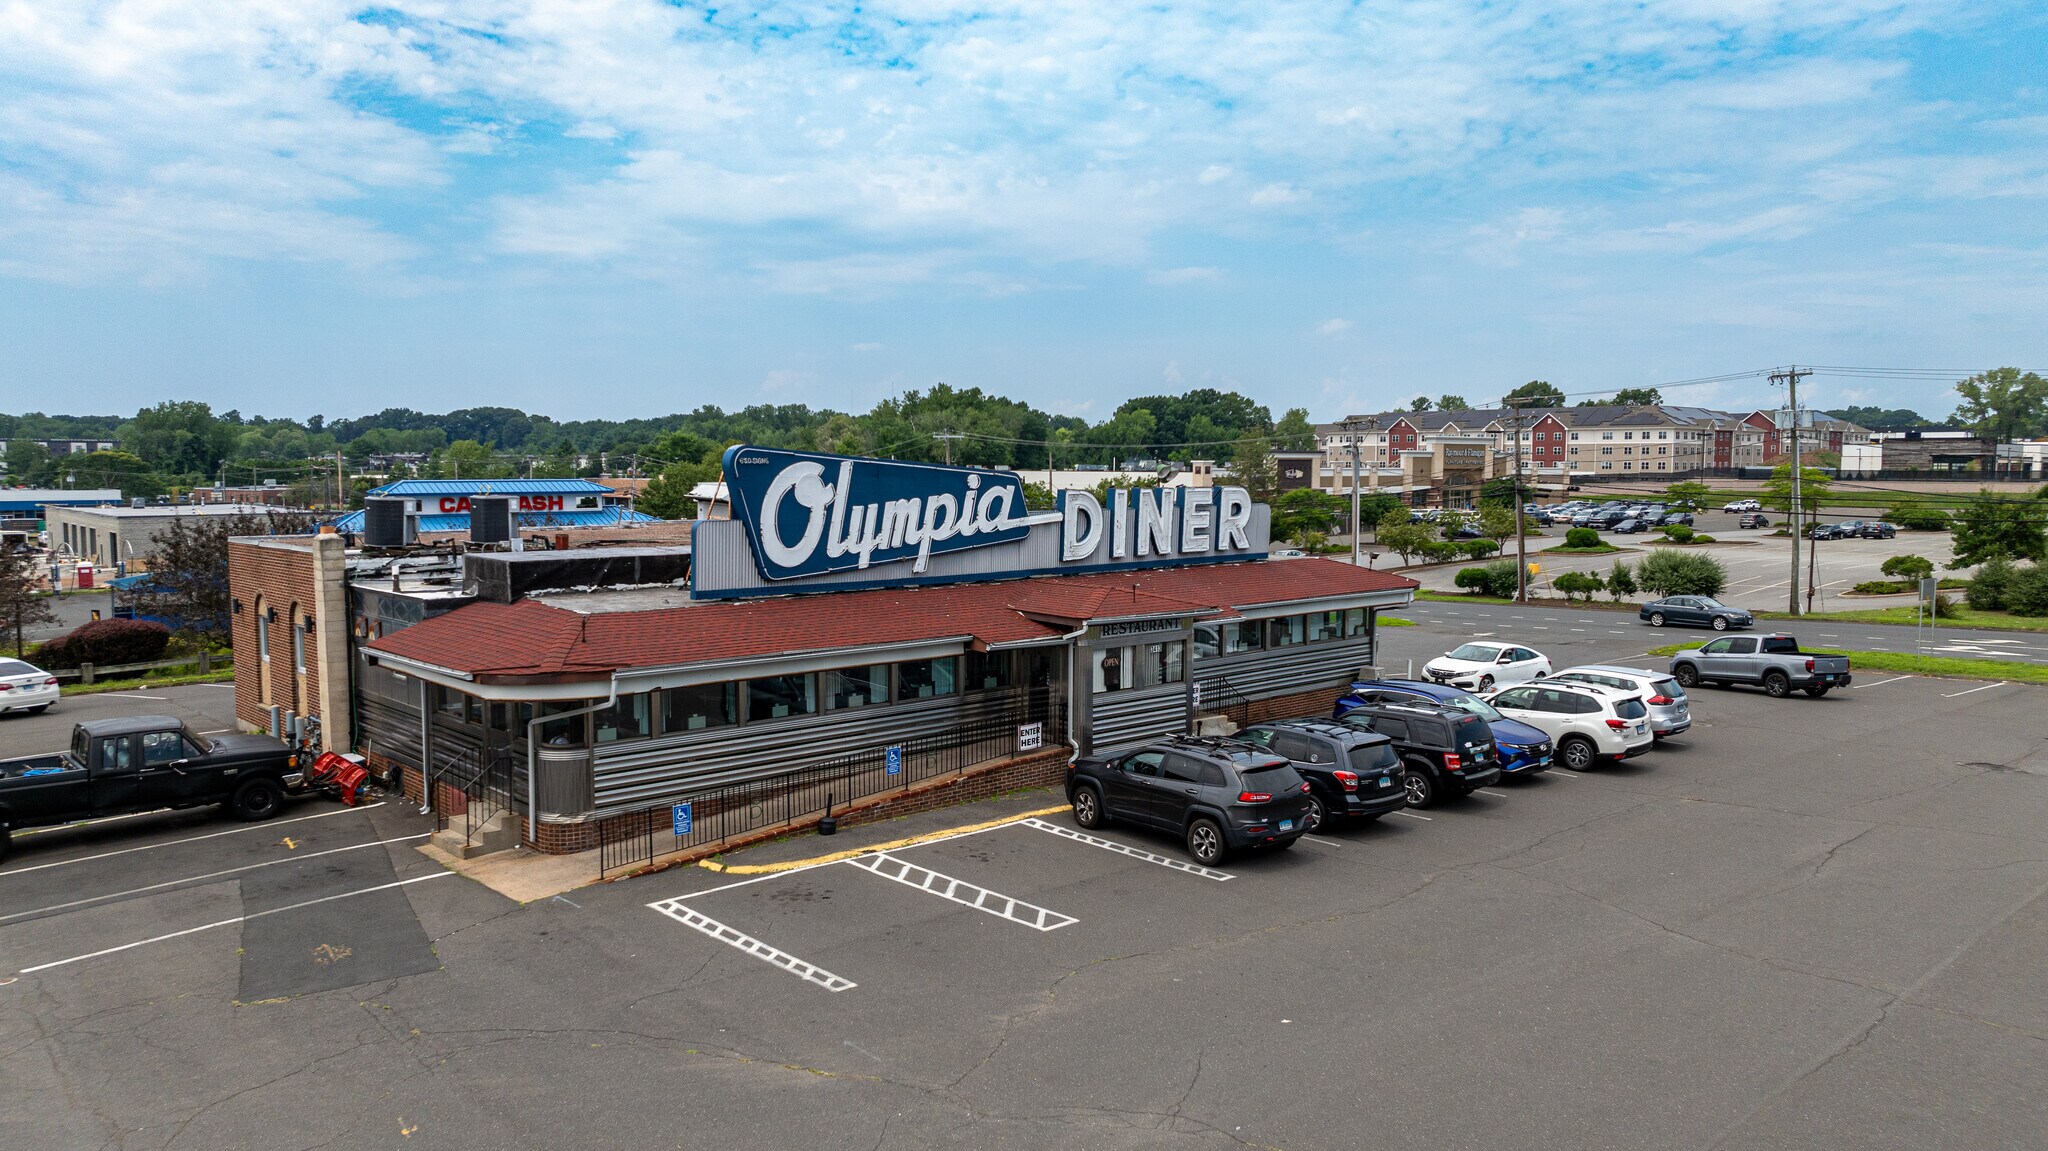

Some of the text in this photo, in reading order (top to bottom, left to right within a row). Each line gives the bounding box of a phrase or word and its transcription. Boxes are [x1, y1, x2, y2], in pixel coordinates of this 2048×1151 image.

[439, 495, 564, 513] CA ASH
[760, 460, 1063, 573] Olympia
[1062, 486, 1252, 561] DINER
[1102, 618, 1180, 636] RESTAURANT
[1104, 658, 1119, 667] OPEN
[1021, 727, 1040, 736] ENTER
[1021, 737, 1040, 746] HERE
